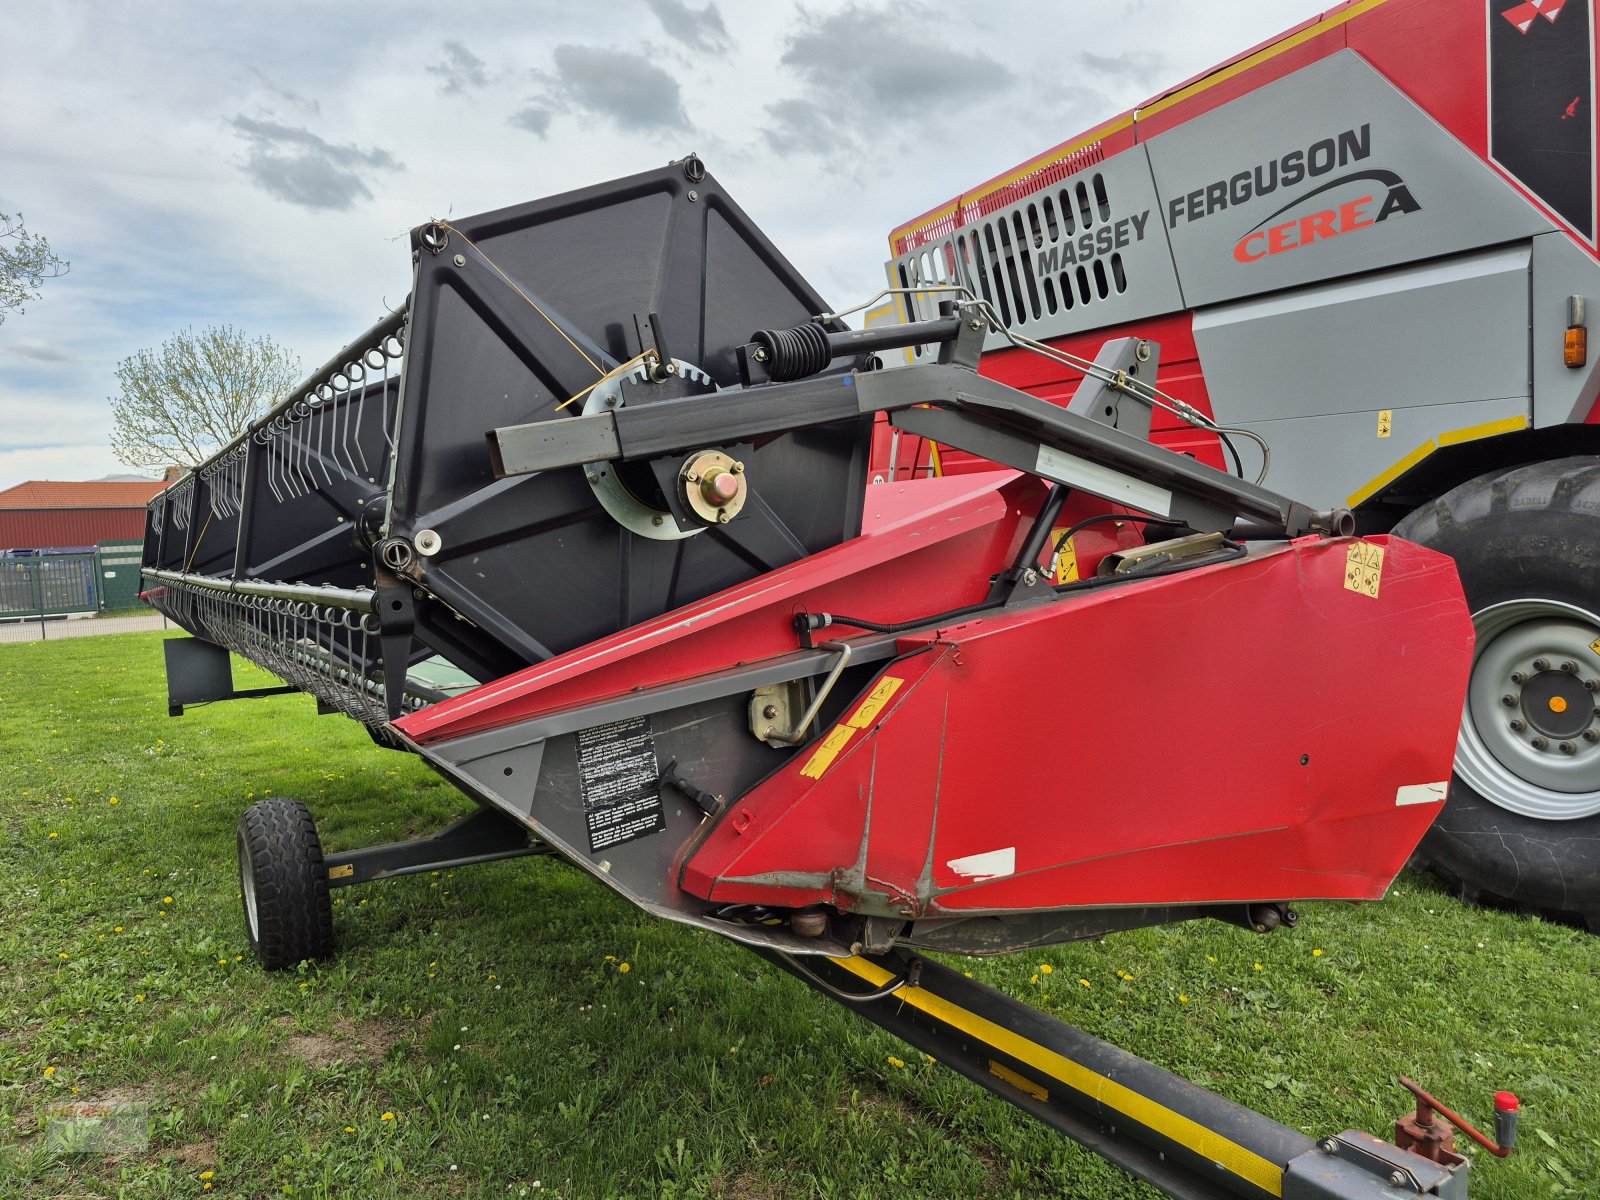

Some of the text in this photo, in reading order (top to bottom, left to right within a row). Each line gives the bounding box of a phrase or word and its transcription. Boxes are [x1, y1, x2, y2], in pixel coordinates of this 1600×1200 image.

[1038, 123, 1371, 278] MASSEY FERGUSON
[1233, 183, 1423, 264] CEREA
